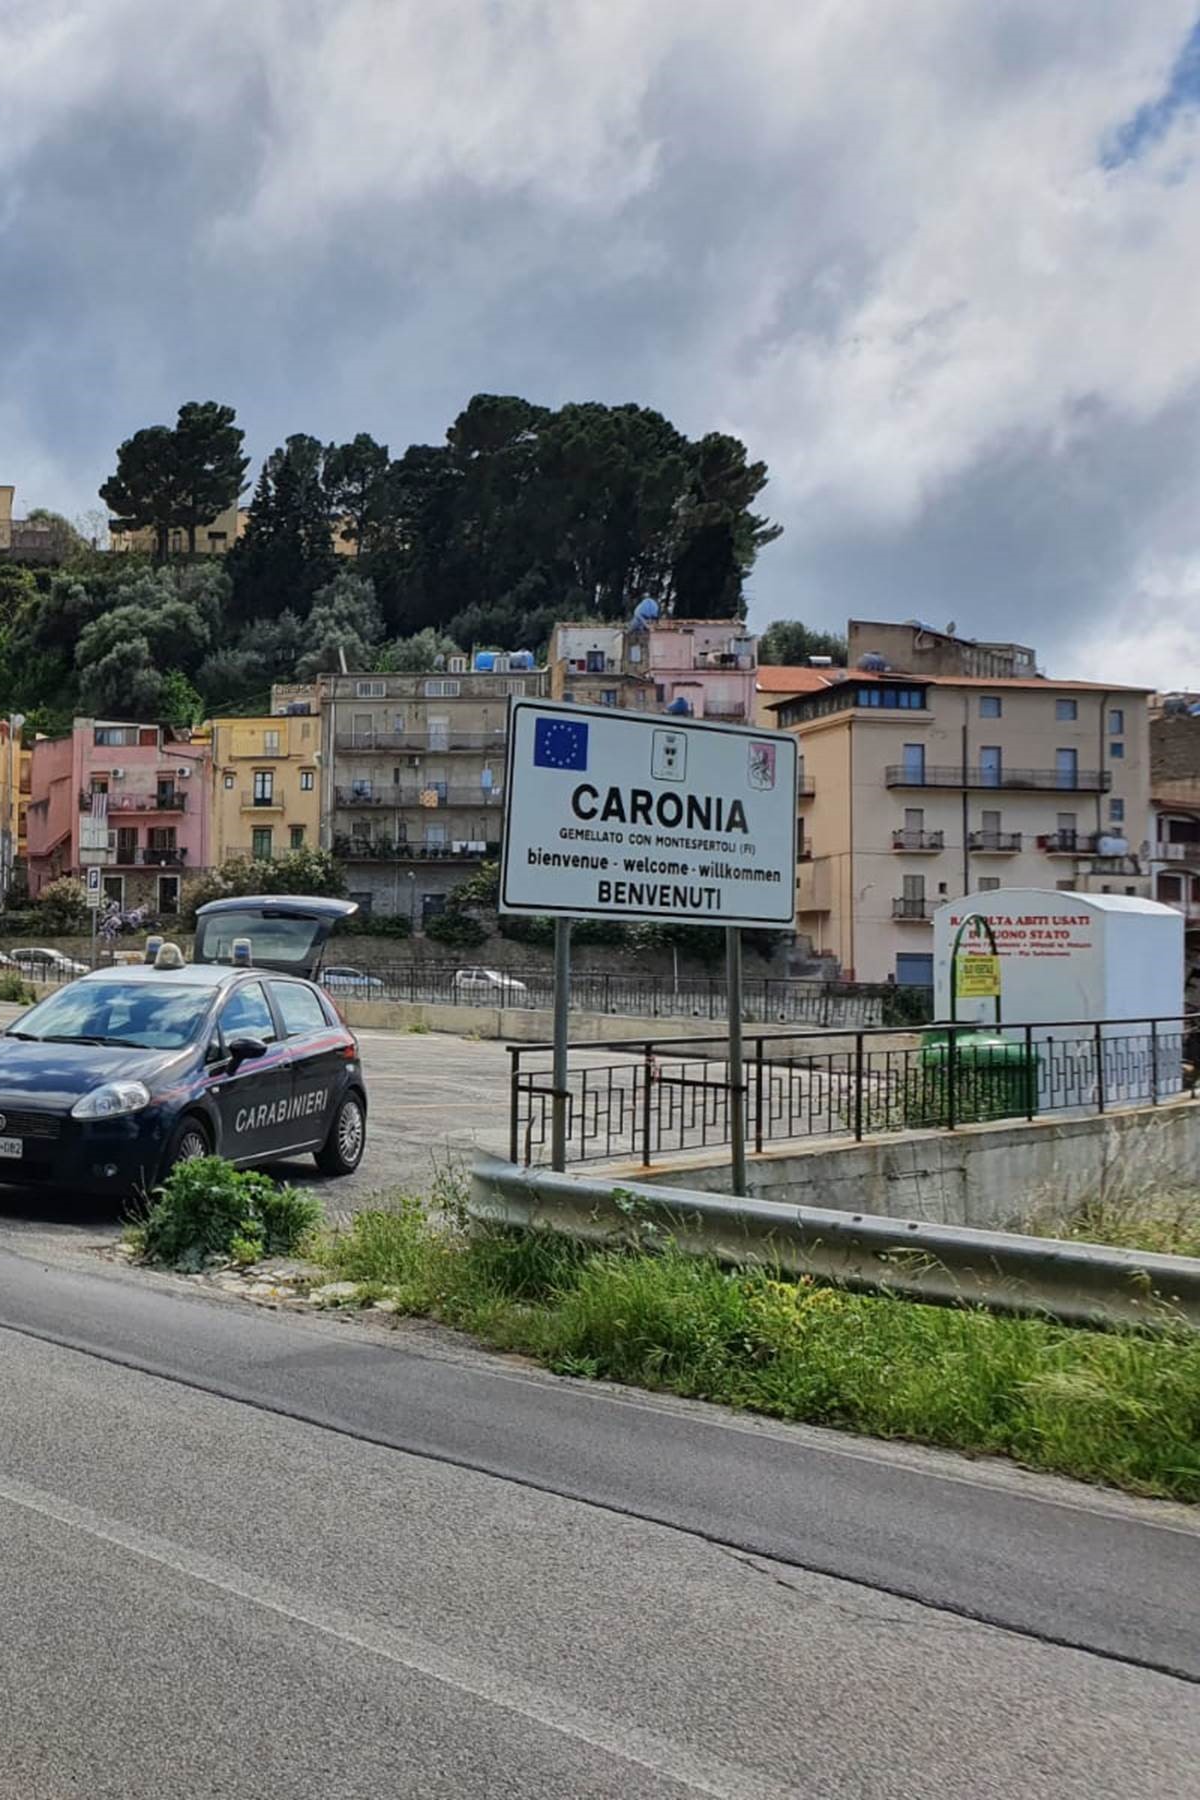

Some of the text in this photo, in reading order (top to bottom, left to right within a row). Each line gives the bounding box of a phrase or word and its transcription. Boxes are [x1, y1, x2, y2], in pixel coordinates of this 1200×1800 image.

[571, 783, 749, 834] CARONIA
[559, 827, 756, 856] GEMELLATO CON MONTESPERTOLI (FI)
[527, 847, 609, 870] bienvenue
[623, 856, 689, 876] welcome
[698, 861, 781, 882] willkommen
[598, 880, 721, 910] BENVENUTI
[1015, 915, 1049, 926] ABITI
[1052, 915, 1090, 926] USATI
[1029, 930, 1070, 939] STATO
[235, 1087, 329, 1133] CARABINIERI
